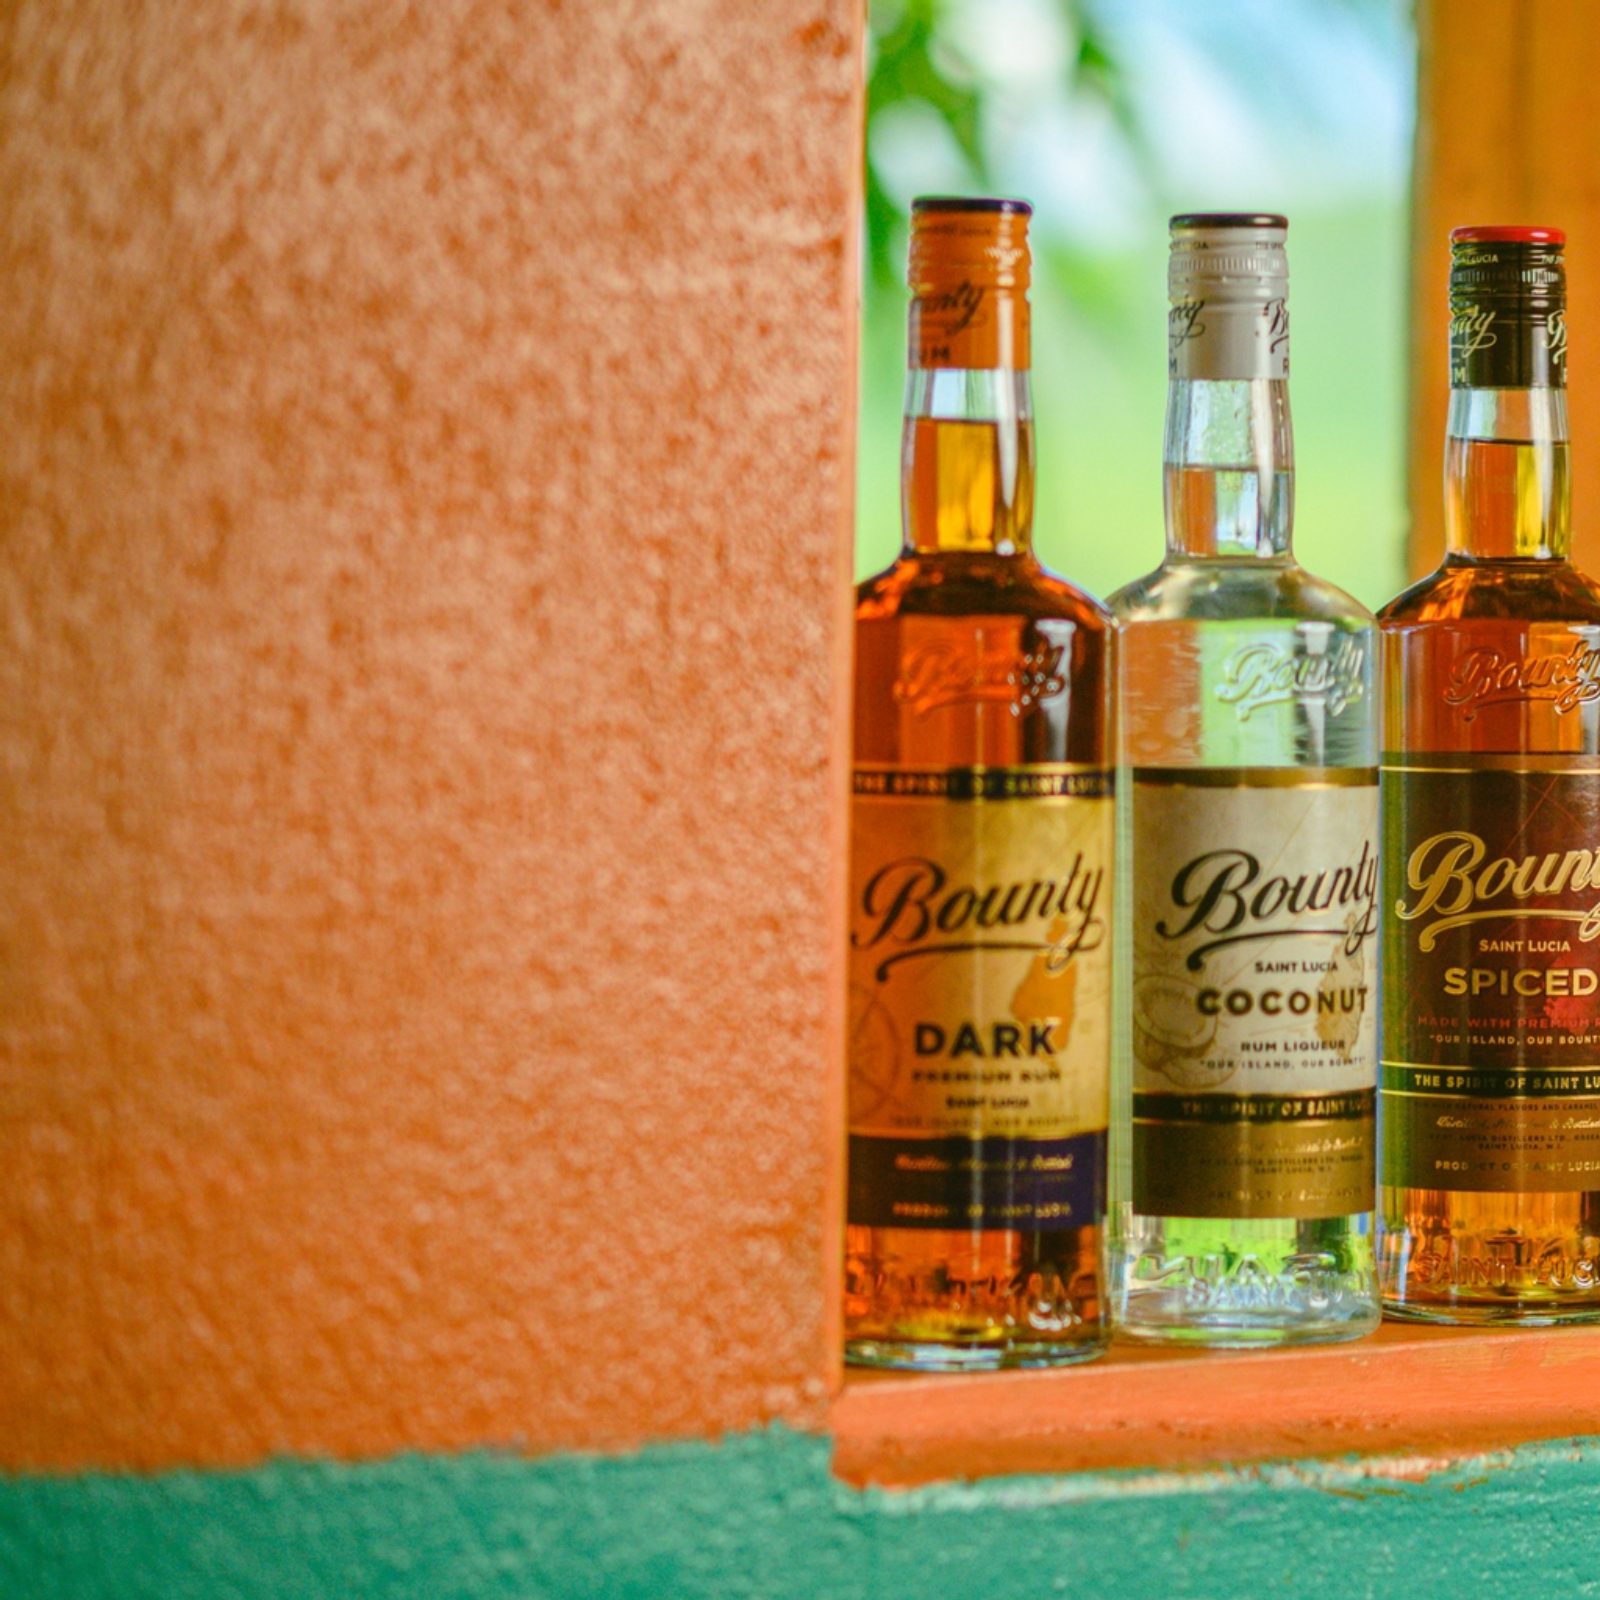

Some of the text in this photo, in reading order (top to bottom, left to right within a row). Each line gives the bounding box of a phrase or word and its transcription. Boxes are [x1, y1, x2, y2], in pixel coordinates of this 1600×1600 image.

[1155, 840, 1379, 972] Bounty
[851, 851, 1106, 982] Bounty
[1479, 939, 1571, 953] SAINT LUCIA
[1254, 960, 1339, 974] SAINT LUCIA
[1443, 966, 1599, 997] SPICED
[1197, 986, 1368, 1016] COCONUT
[1417, 1016, 1459, 1028] MADE
[1466, 1017, 1511, 1029] WITH
[1516, 1016, 1591, 1030] PREMIUM
[914, 1021, 1056, 1057] DARK
[1240, 1039, 1346, 1052] RUM LIQUEUR
[1526, 1035, 1554, 1045] OUR
[1414, 1073, 1441, 1088] THE
[1446, 1075, 1498, 1089] SPIRIT
[1505, 1076, 1526, 1090] OF
[1532, 1076, 1580, 1090] SAINT
[1306, 1098, 1346, 1117] SAINT
[1435, 1159, 1496, 1171] PRODCT
